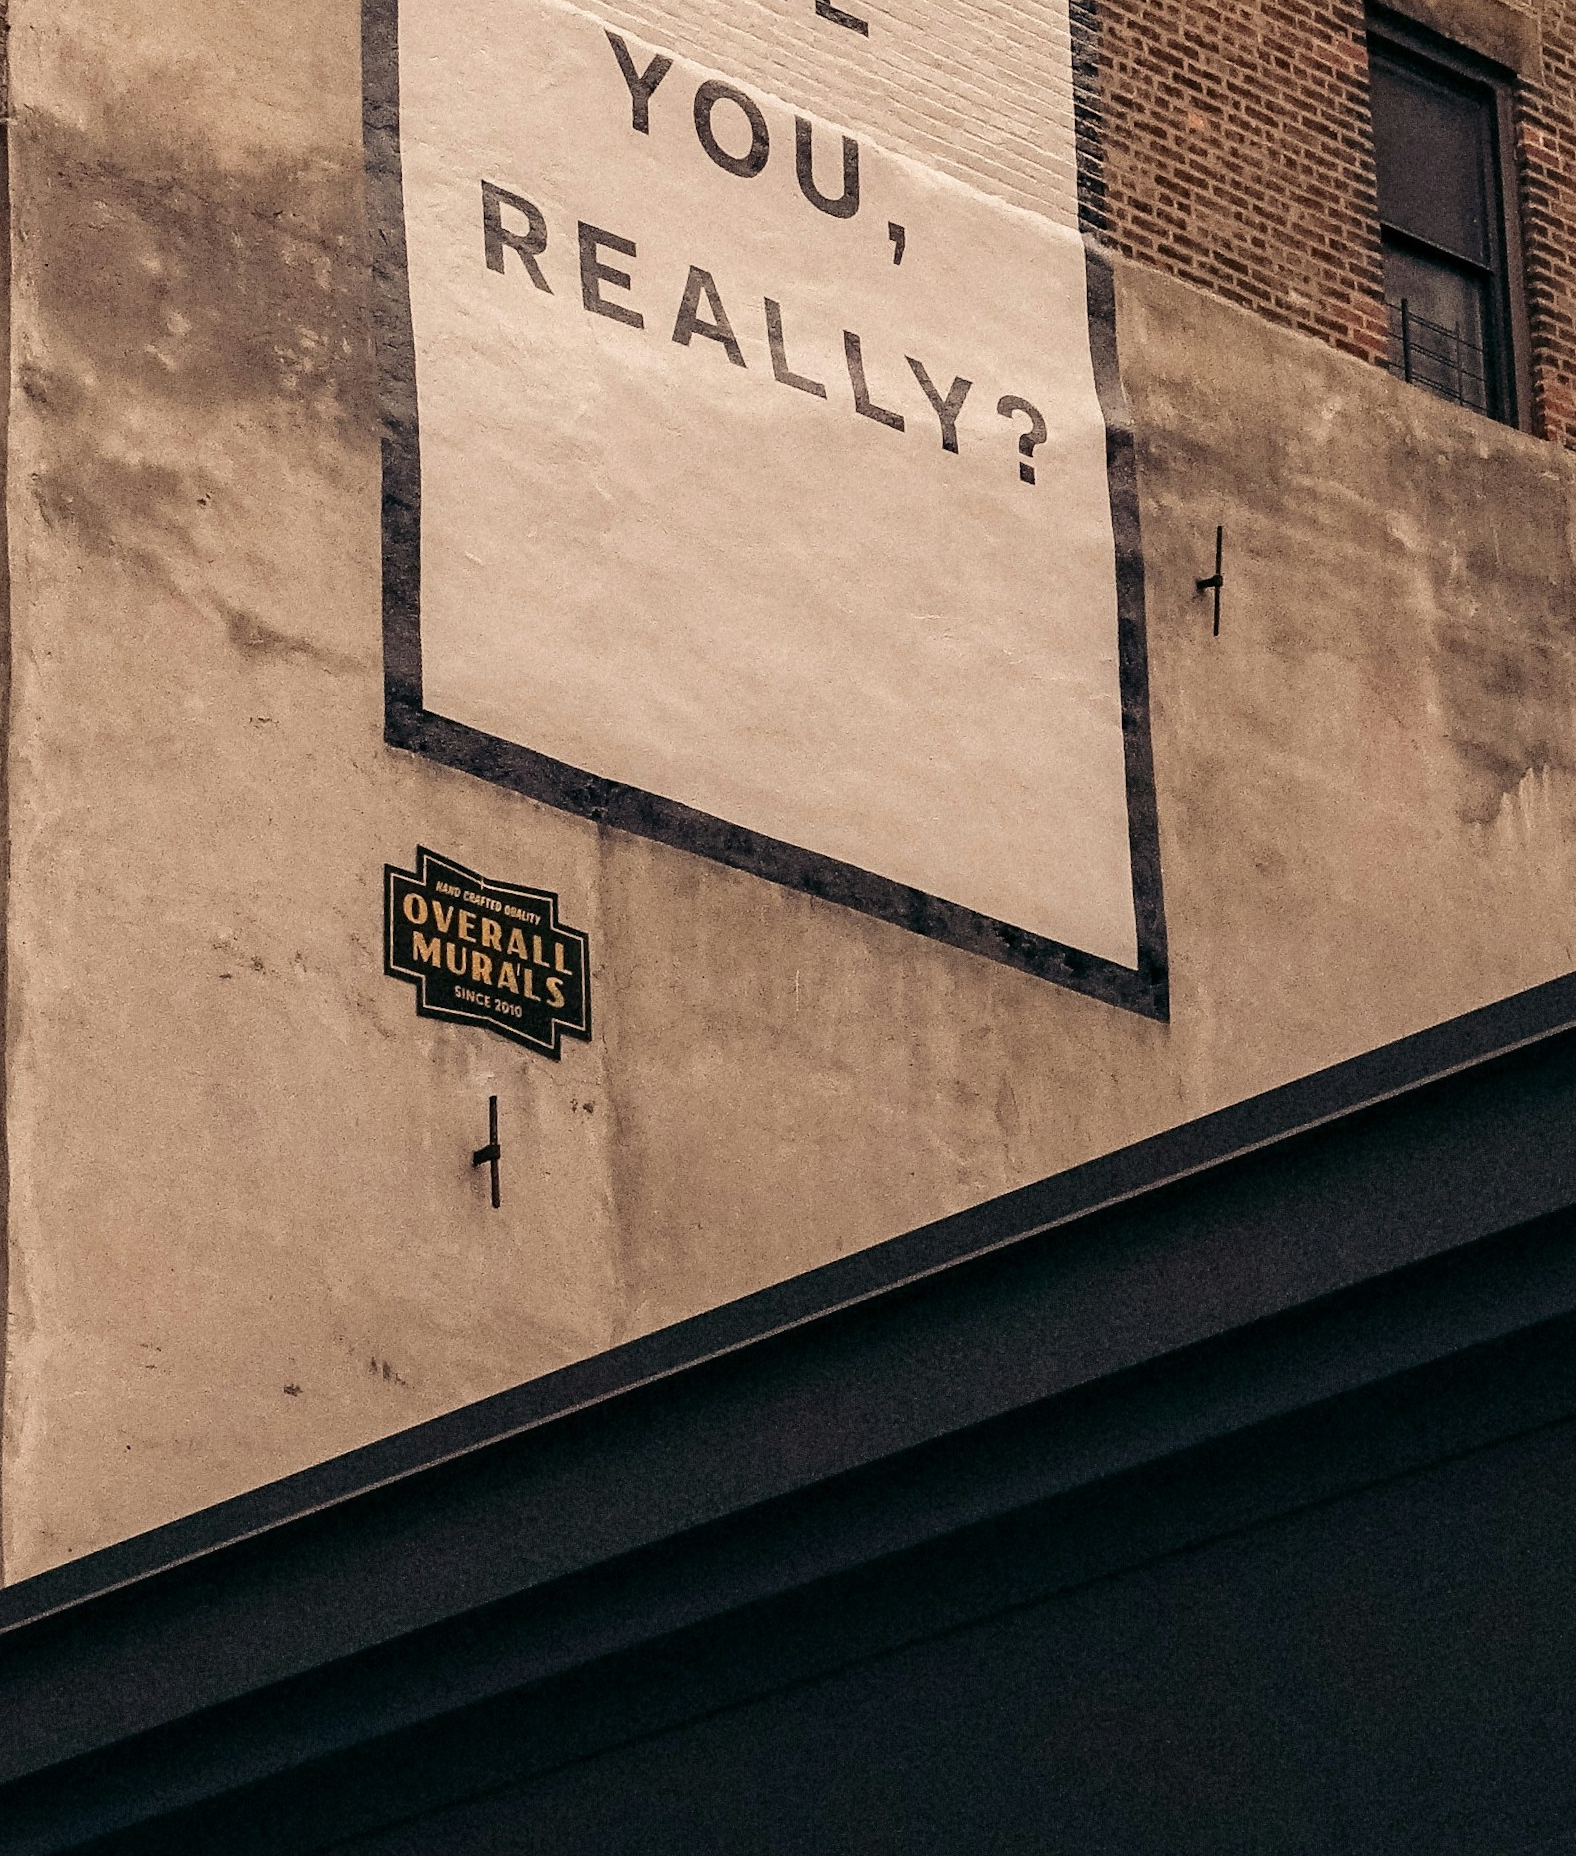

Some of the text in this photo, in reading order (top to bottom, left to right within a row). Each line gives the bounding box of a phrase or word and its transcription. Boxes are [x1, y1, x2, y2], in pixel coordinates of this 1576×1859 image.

[604, 29, 907, 267] YOU,
[480, 179, 1049, 486] REALLY?
[402, 892, 573, 976] OVERALL
[435, 880, 541, 926] HAND CRAFTED QUALITY
[454, 984, 523, 1018] SINCE 2010
